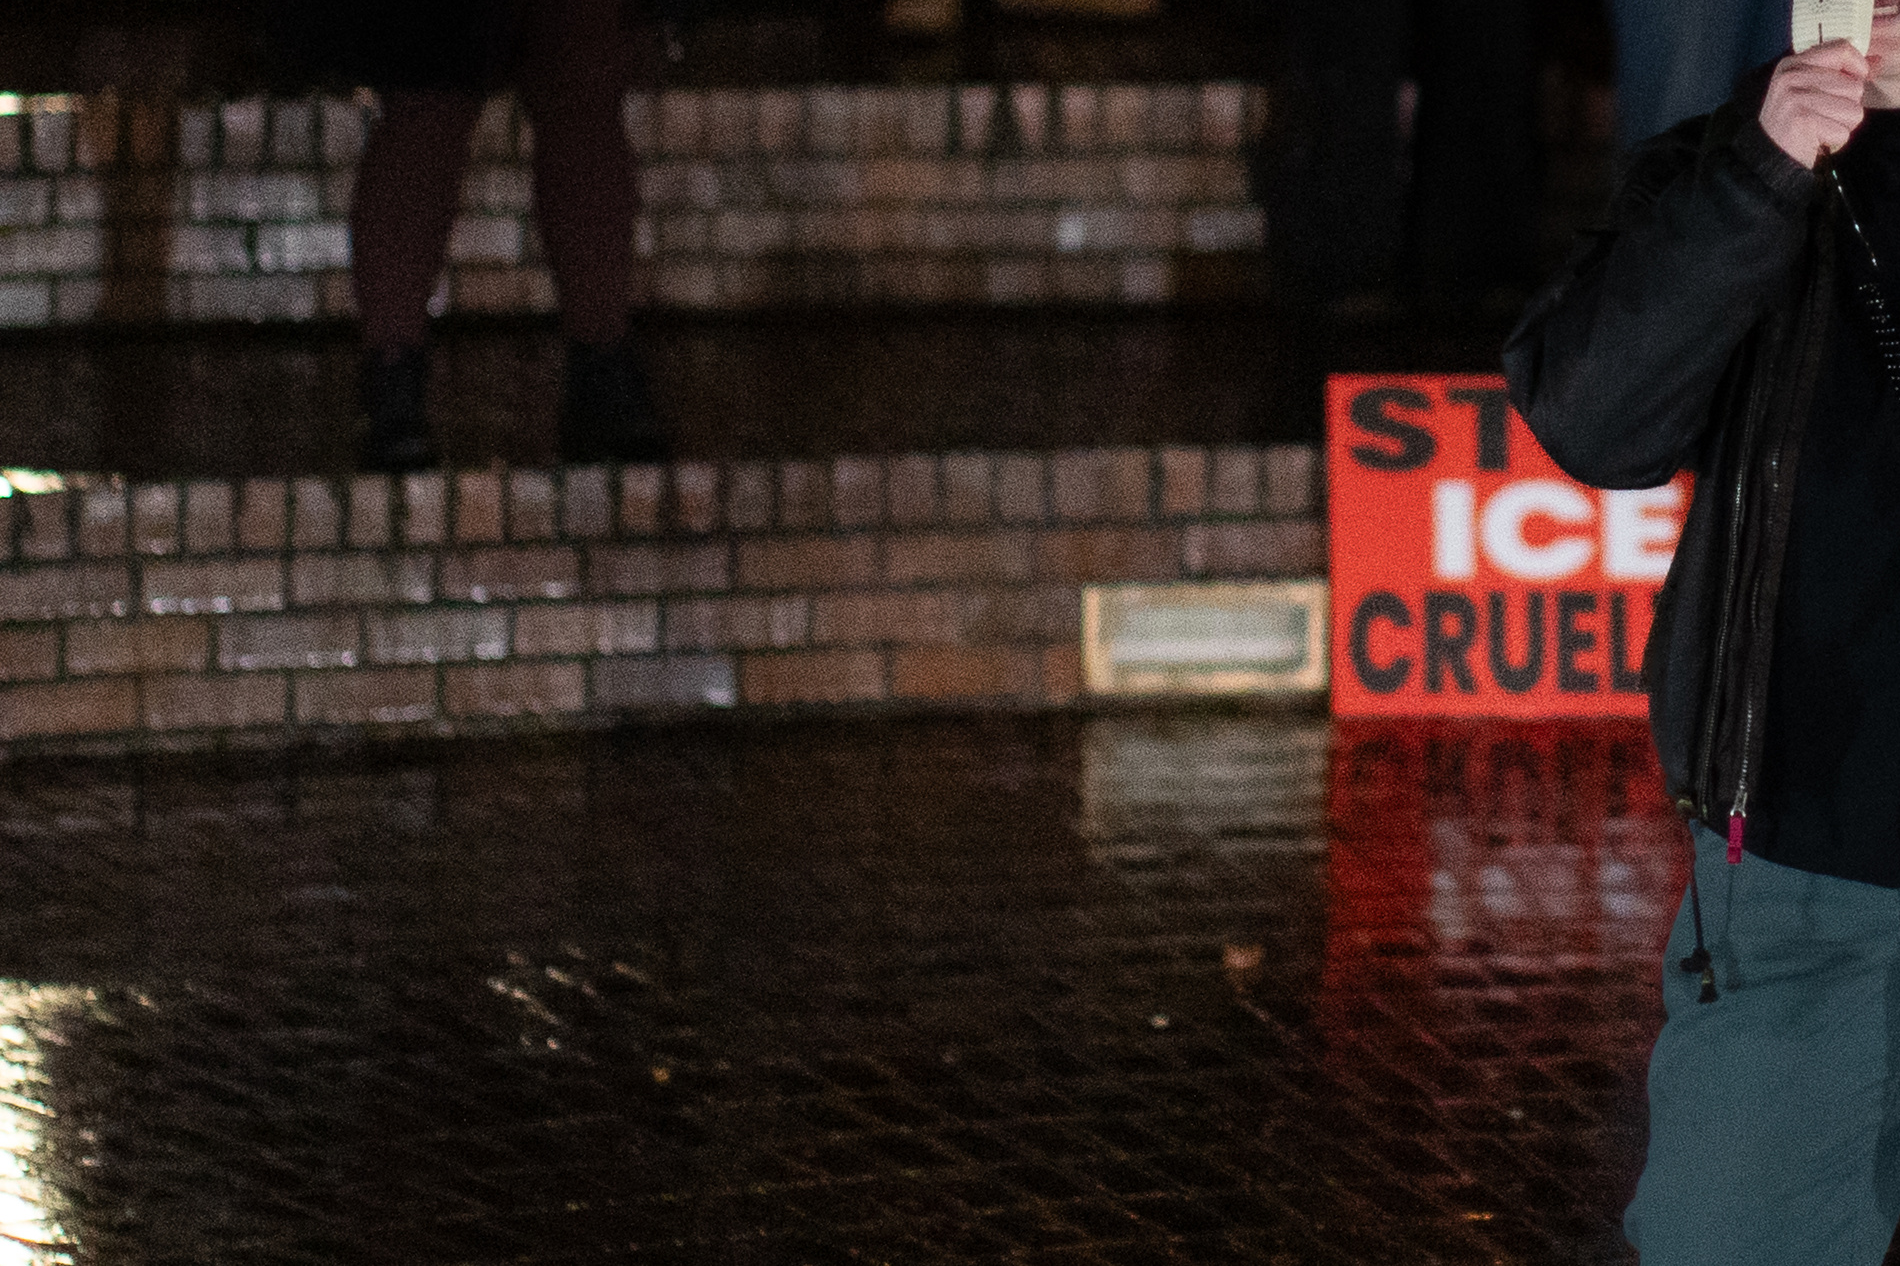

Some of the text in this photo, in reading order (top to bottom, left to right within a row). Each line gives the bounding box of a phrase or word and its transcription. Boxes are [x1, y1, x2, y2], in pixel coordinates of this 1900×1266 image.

[1348, 386, 1511, 472] ST
[1433, 478, 1685, 582] ICE
[1349, 591, 1656, 694] CRUEL
